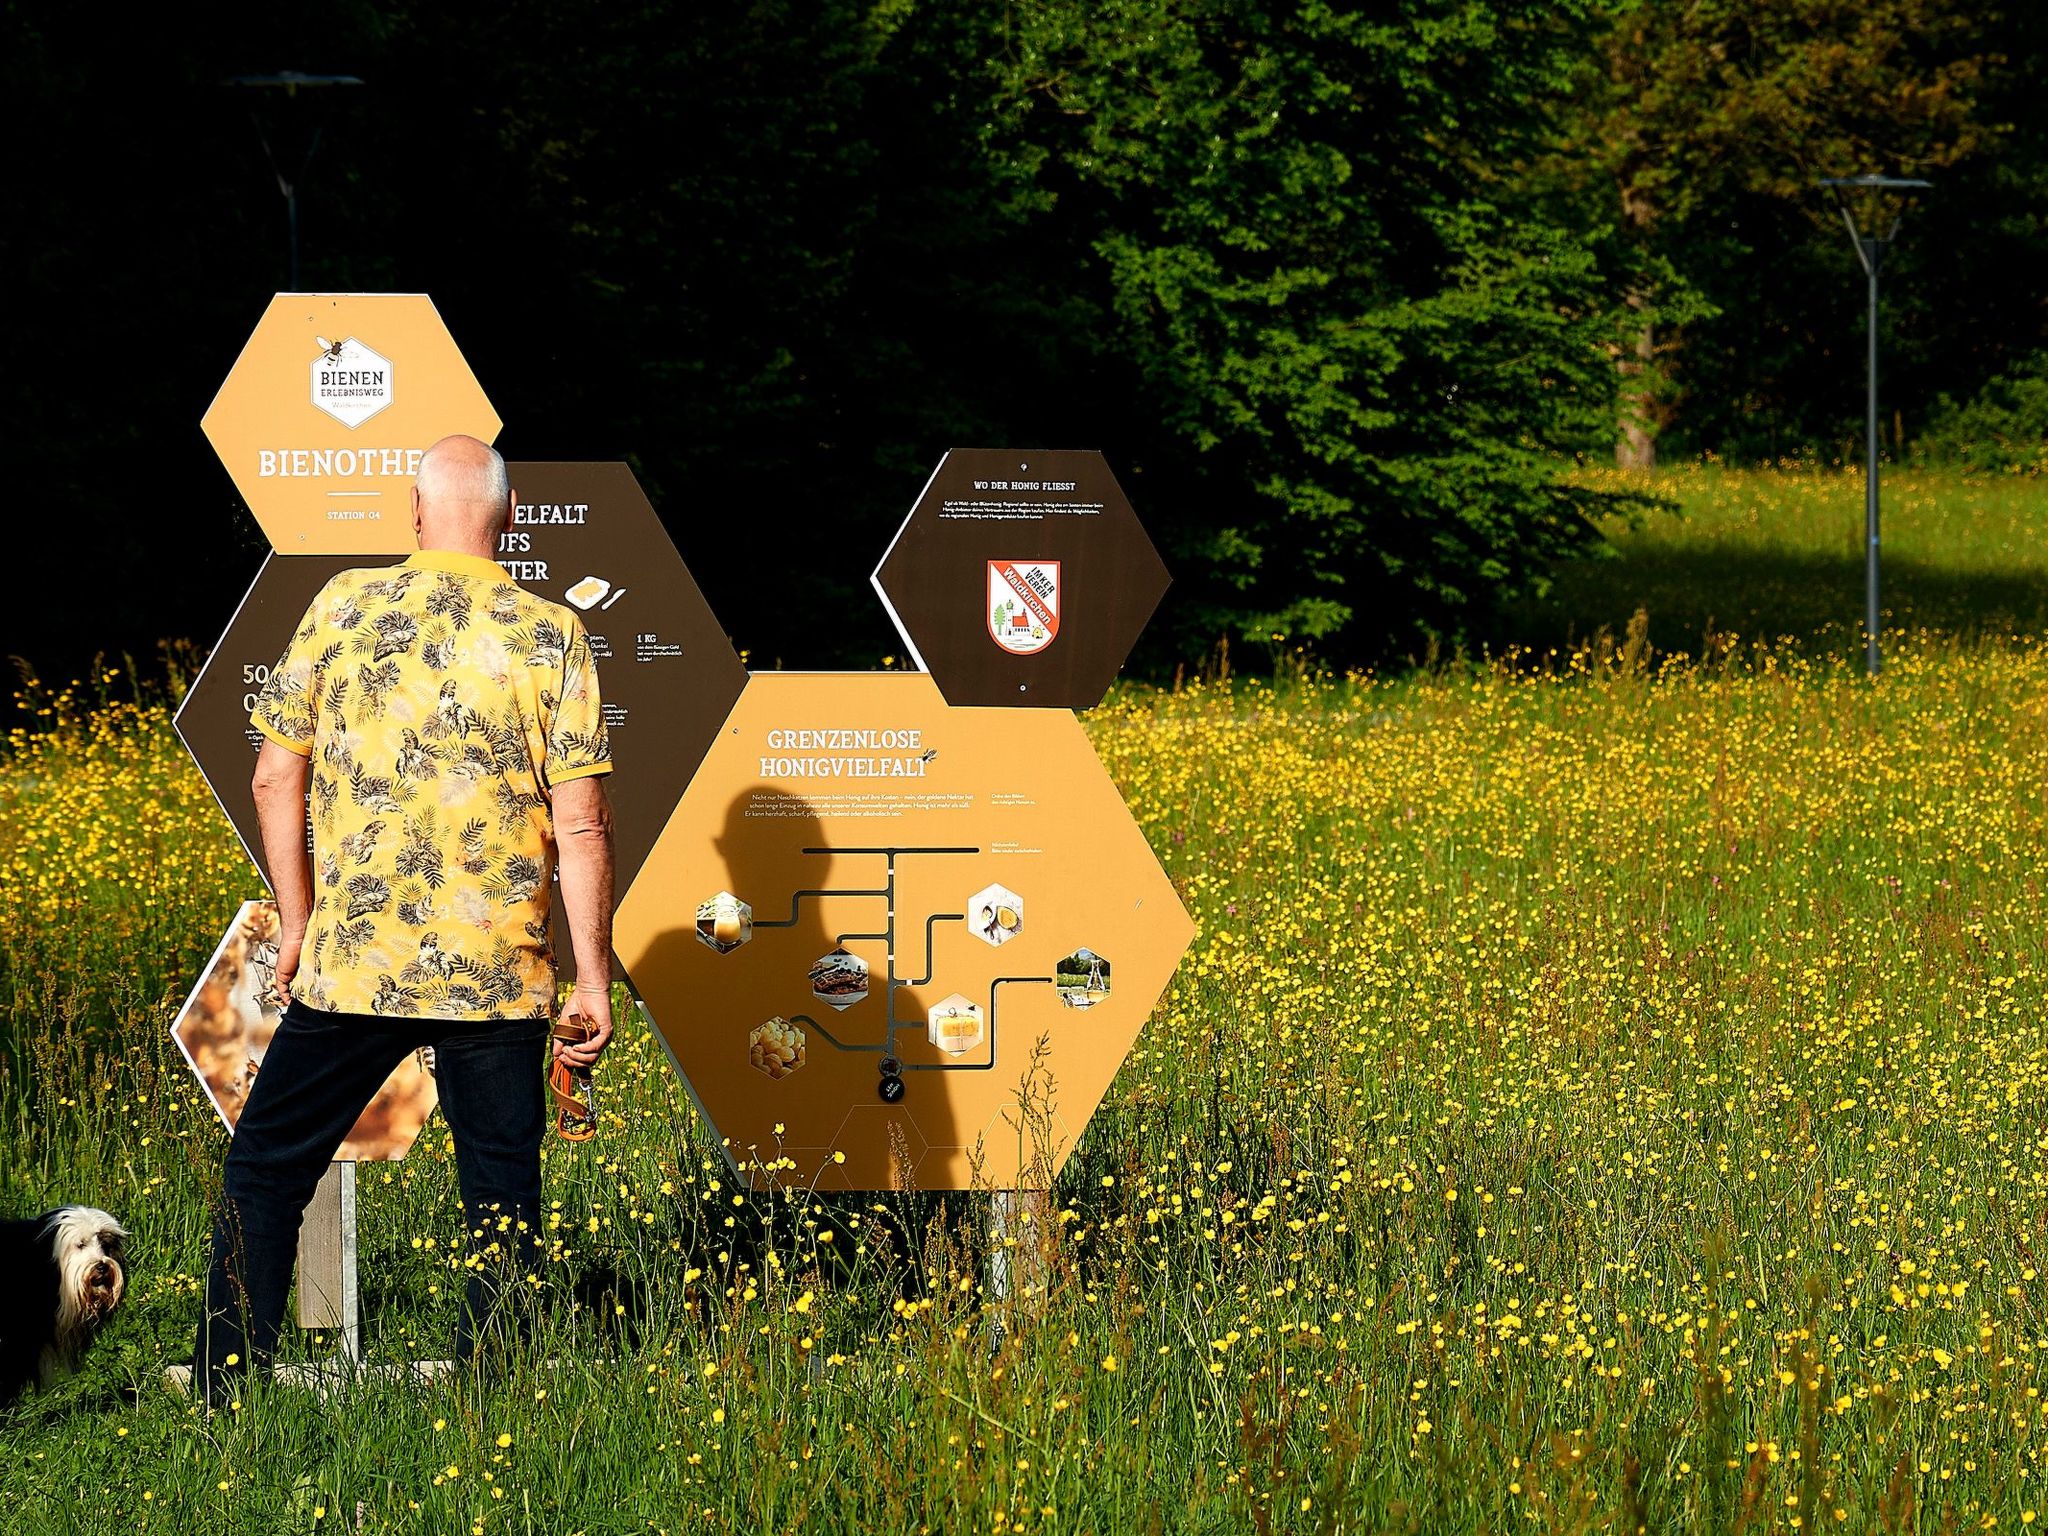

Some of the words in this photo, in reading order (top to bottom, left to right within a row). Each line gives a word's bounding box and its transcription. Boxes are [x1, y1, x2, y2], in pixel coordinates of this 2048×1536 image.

[321, 371, 384, 385] BIENEN
[321, 388, 384, 397] ERLEBNISWEG
[258, 449, 424, 477] BIENOTHE
[973, 481, 989, 490] WO
[991, 481, 1009, 490] DER
[1011, 482, 1040, 490] HONIG
[1042, 482, 1076, 491] FLIESST
[327, 511, 365, 520] STATION
[514, 504, 589, 524] ELFALT
[1024, 572, 1049, 599] VEREIN
[1031, 566, 1055, 594] IMKER
[1003, 567, 1051, 625] Waldkirchen
[637, 634, 642, 643] 1
[644, 634, 657, 643] KG
[767, 730, 923, 750] GRENZENLOSE
[759, 756, 928, 778] HONIGVIELFALT
